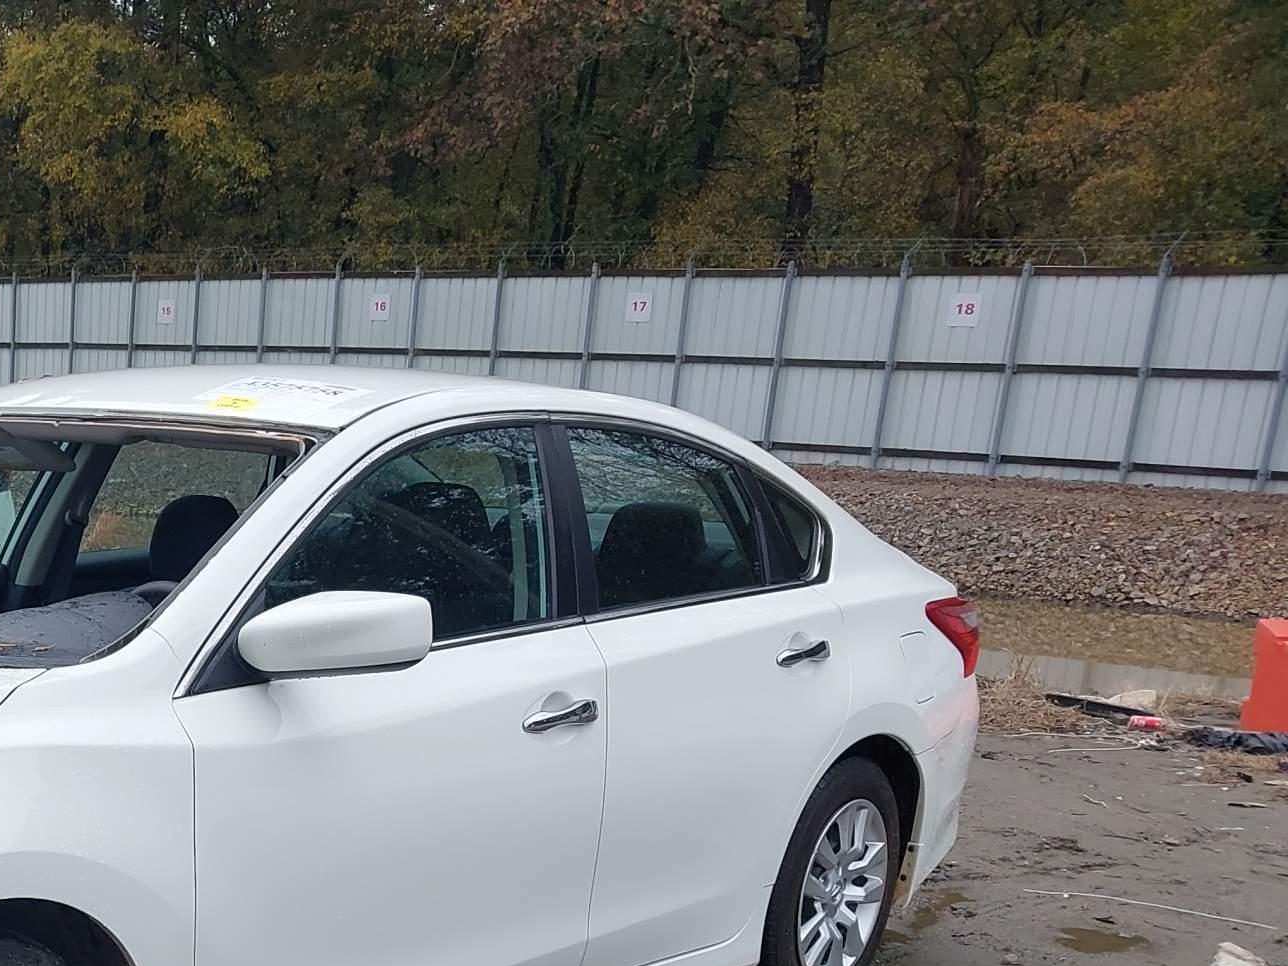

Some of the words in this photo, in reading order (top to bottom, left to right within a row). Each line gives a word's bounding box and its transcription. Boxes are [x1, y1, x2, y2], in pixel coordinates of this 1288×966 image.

[161, 306, 172, 316] 15
[374, 301, 386, 312] 16
[631, 301, 648, 312] 17
[956, 303, 975, 315] 18
